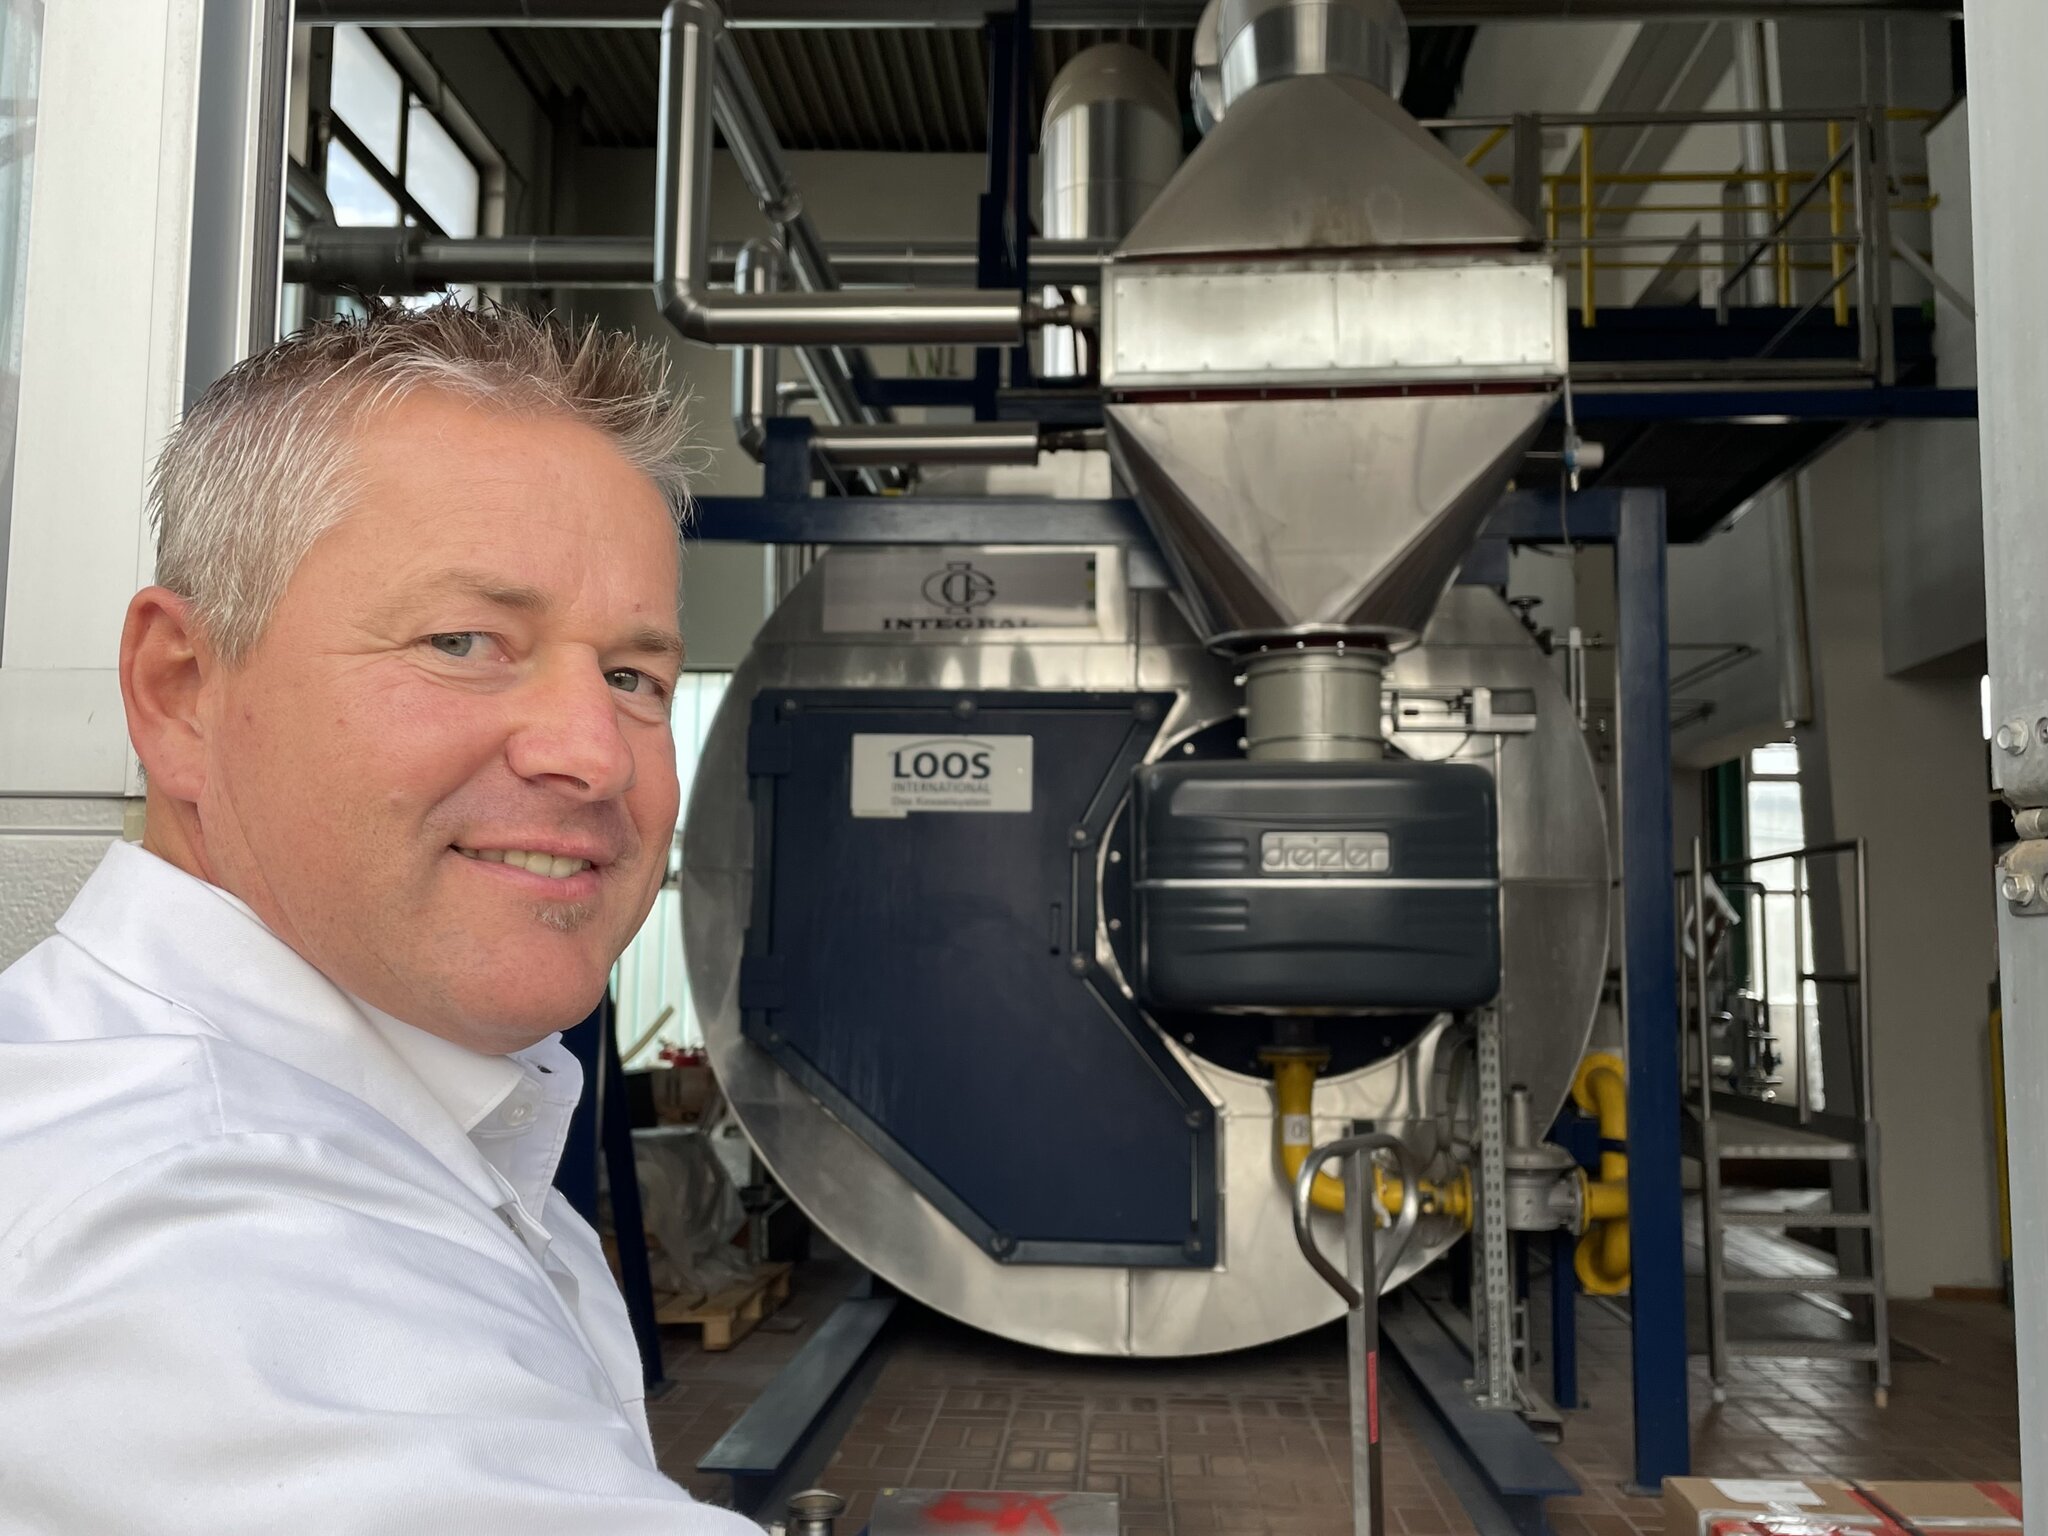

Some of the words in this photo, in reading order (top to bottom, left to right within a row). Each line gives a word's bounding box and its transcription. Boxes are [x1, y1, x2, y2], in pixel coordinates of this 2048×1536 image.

[884, 617, 1037, 630] INTEGRAL
[893, 751, 990, 779] LOOS
[891, 782, 990, 794] INTERNATIONAL
[1263, 836, 1388, 869] dreizler
